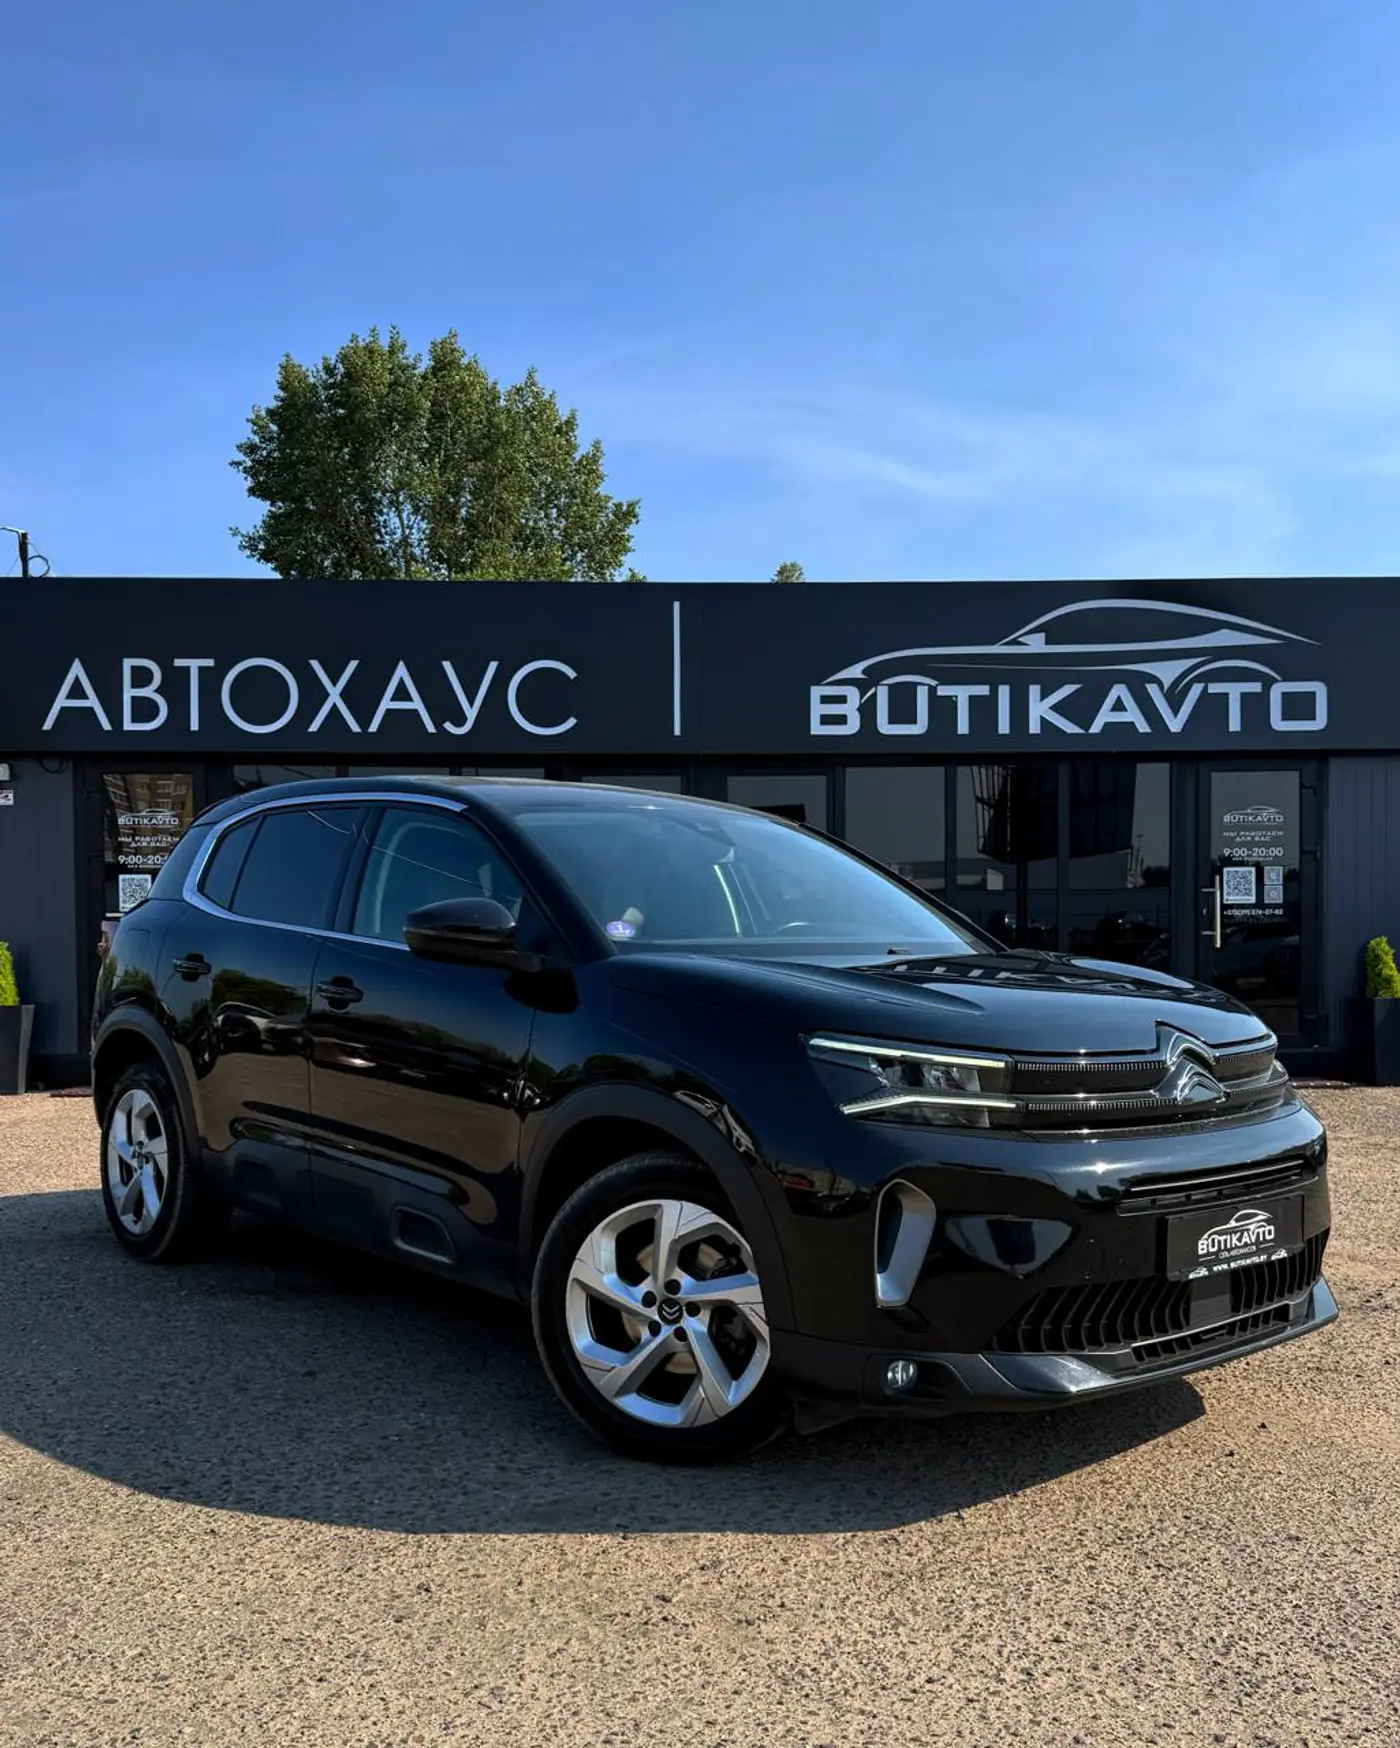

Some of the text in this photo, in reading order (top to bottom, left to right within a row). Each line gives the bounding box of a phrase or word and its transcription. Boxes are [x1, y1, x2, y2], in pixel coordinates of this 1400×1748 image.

[42, 657, 578, 735] АВТОХАУС
[810, 680, 1328, 736] BUTIKAVTO
[118, 816, 179, 825] BUTIKAVTO
[1223, 814, 1284, 822] BUTIKAVTO
[1223, 847, 1284, 857] 9:00-20:00
[1197, 1225, 1275, 1255] BUTIKAVTO
